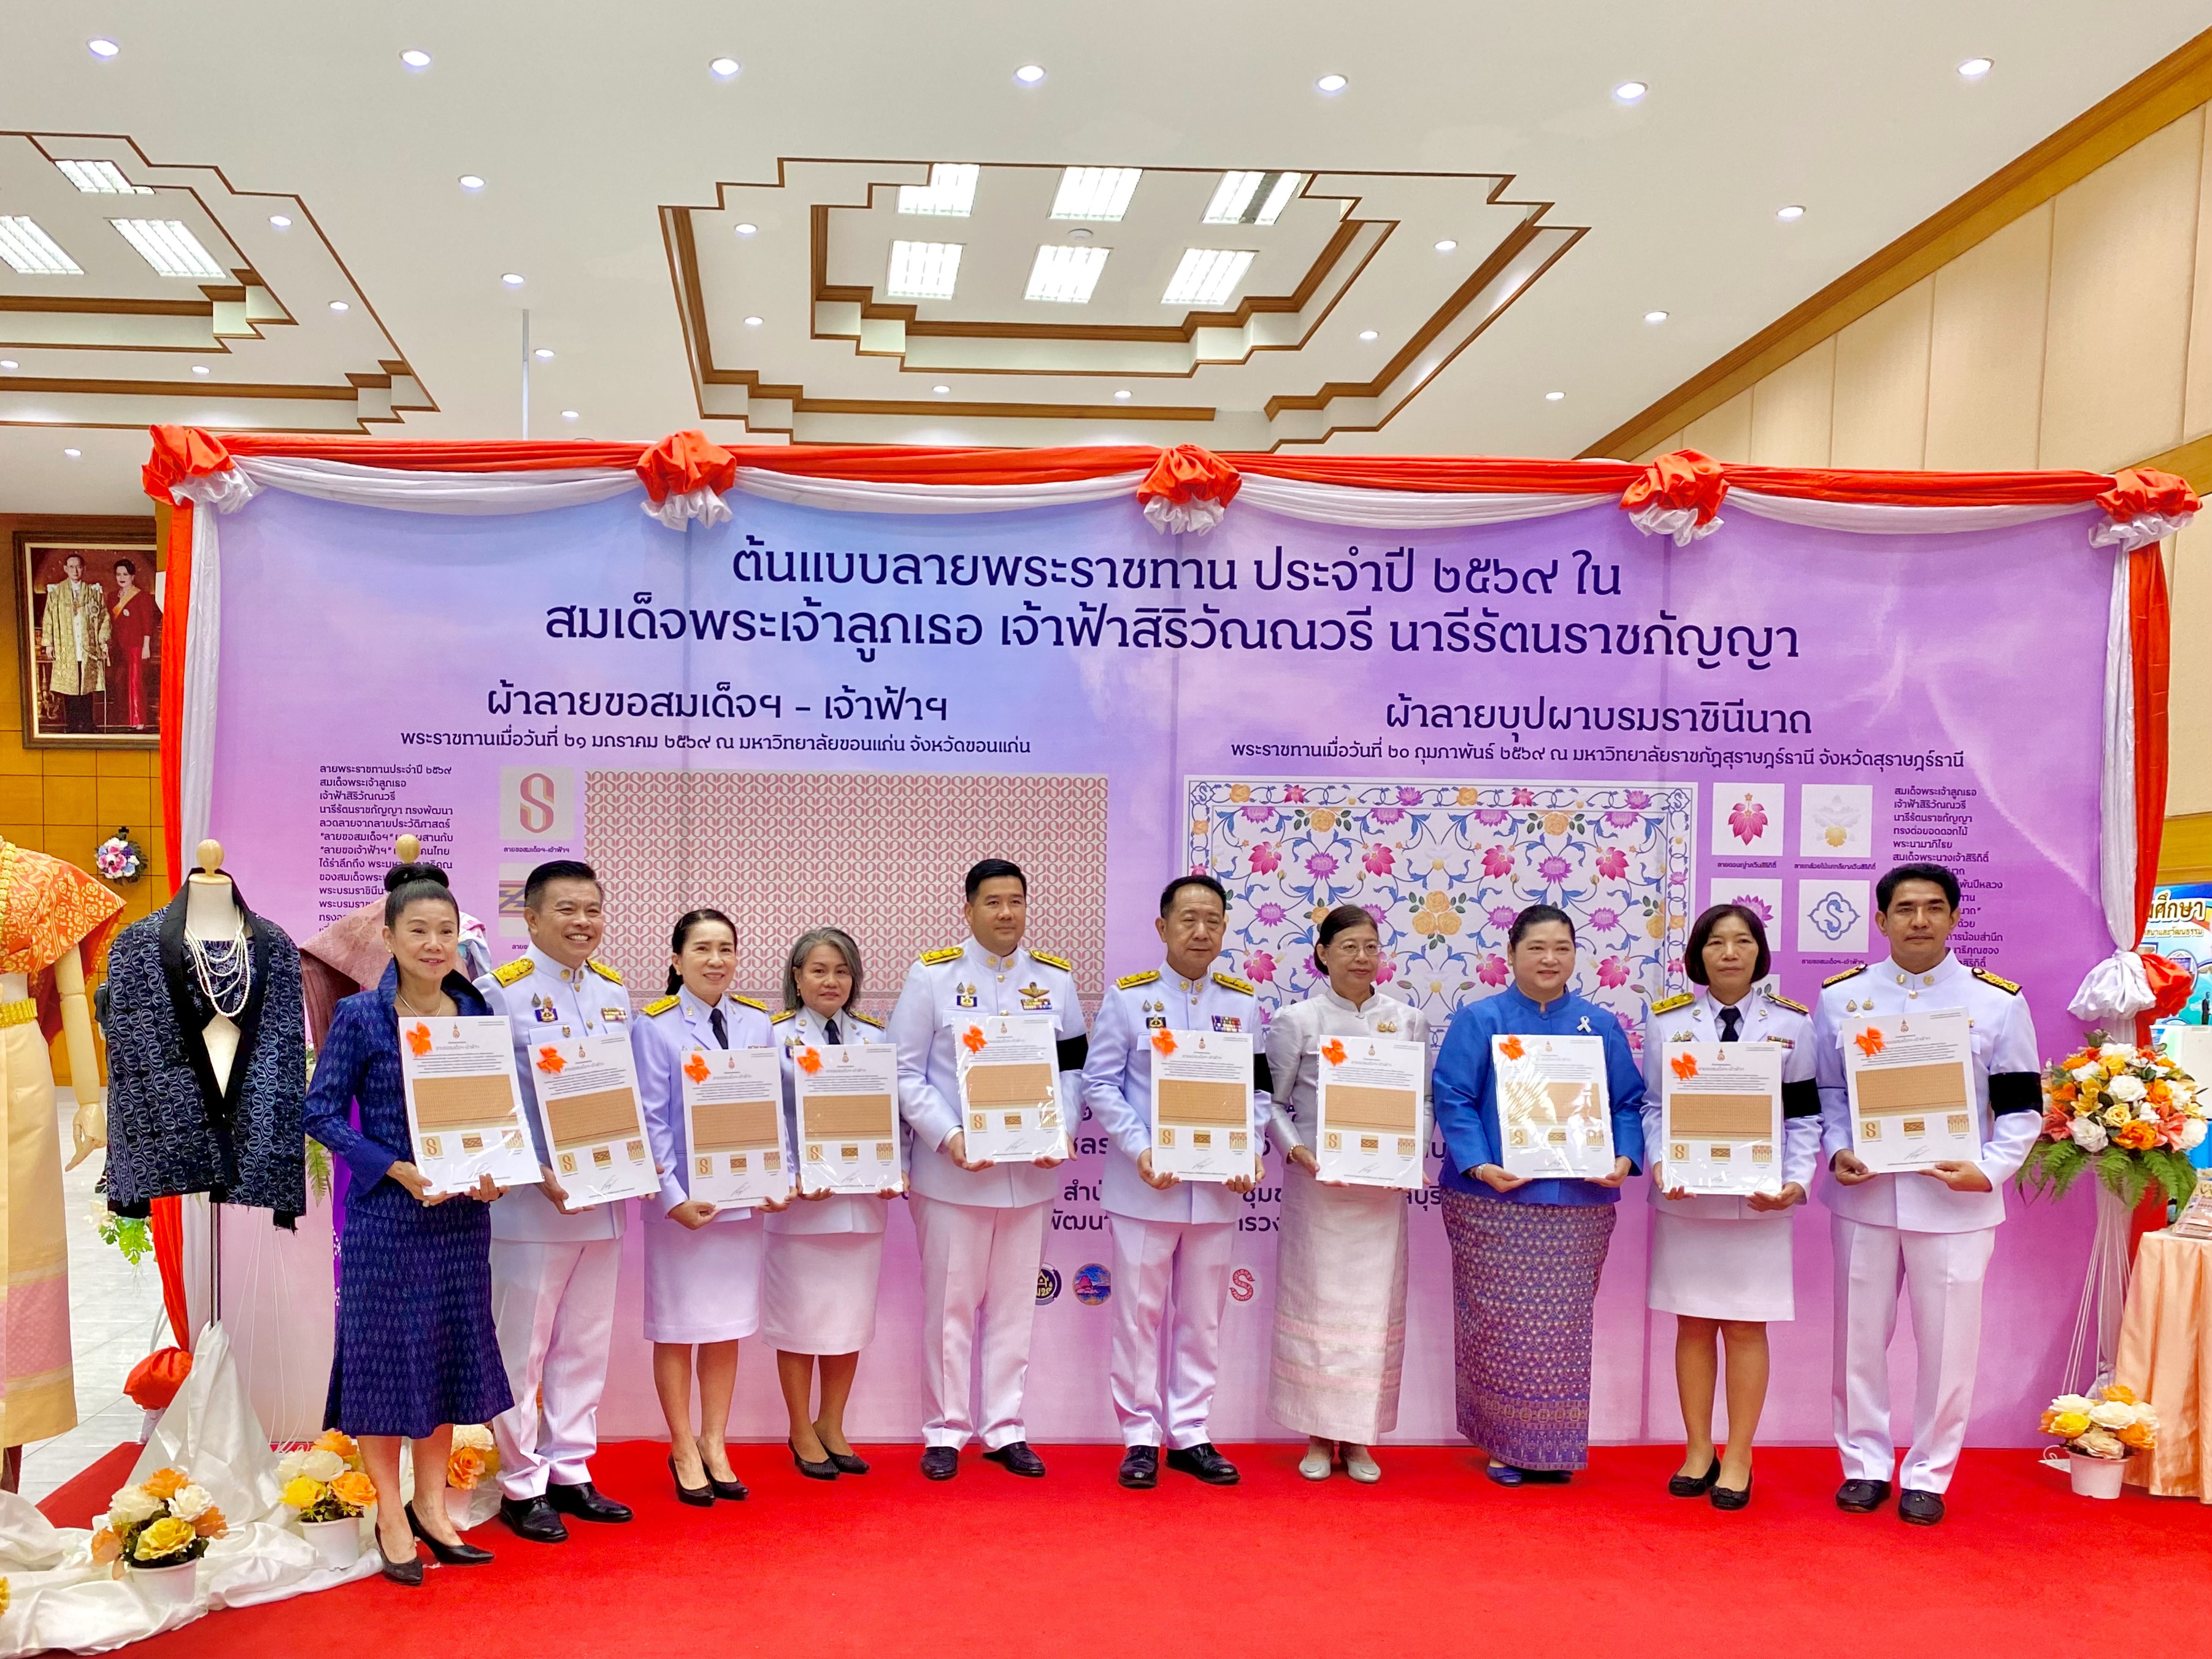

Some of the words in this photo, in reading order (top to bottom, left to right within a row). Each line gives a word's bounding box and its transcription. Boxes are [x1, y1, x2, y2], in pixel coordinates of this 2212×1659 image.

[733, 536, 1237, 590] ต้นแบบลายพระราชทาน
[1254, 545, 1415, 593] ประจำปี
[1434, 558, 1558, 595] ๒๕๖๙
[1572, 549, 1621, 595] ใน
[546, 591, 983, 663] สมเด็จพระเจ้าลูกเธอ
[1002, 600, 1373, 651] เจ้าฟ้าสิริวัณณวรี
[1389, 606, 1799, 669] นารีรัตนราชกัญญา
[488, 679, 781, 718] ผ้าลายขอสมเด็จฯ
[825, 685, 947, 721] เจ้าฟ้าฯ
[1387, 693, 1812, 741] ผ้าลายบุปผาบรมราชินีนาถ
[400, 725, 558, 747] พระราชทานเมื่อวันที่
[564, 734, 586, 749] ๒๑
[591, 735, 658, 749] มกราคม
[664, 734, 711, 749] ๒๕๖๙
[716, 737, 734, 749] ณ
[739, 733, 905, 752] มหาวิทยาลัยขอนแก่น
[910, 734, 1031, 753] จังหวัดขอนแก่น
[1231, 736, 1383, 758] พระราชทานเมื่อวันที่
[1388, 745, 1410, 758] ๒๐
[1415, 742, 1496, 763] กุมภาพันธ์
[1500, 745, 1545, 760] ๒๕๖๙
[1550, 749, 1568, 761] ณ
[1573, 745, 1815, 770] มหาวิทยาลัยราชภัฏสุราษฎร์ธานี
[1819, 748, 1964, 772] จังหวัดสุราษฎร์ธานี
[320, 764, 423, 774] ลายพระราชทานประจำปี
[320, 776, 407, 791] สมเด็จพระเจ้าลูกเธอ
[320, 790, 396, 801] เจ้าฟ้าสิริวัณณวรี
[1894, 785, 1977, 799] สมเด็จพระเจ้าลูกเธอ
[320, 803, 403, 817] นารีรัตนราชกัญญา
[405, 805, 453, 815] ทรงพัฒนา
[1894, 798, 1966, 809] เจ้าฟ้าสิริวัณณวรี
[320, 818, 451, 828] ลวดลายจากลายประวัติศาสตร์
[1894, 812, 1973, 825] นารีรัตนราชกัญญา
[1893, 825, 1968, 836] ทรงต่อยอดดอกไม้
[1892, 839, 1953, 849] พระนามาภิไธย
[318, 858, 365, 868] ได้รำลึกถึง
[320, 871, 385, 881] ของสมเด็จพระ
[319, 885, 385, 895] พระบรมราชินีน
[2149, 893, 2203, 919] ศึกษา
